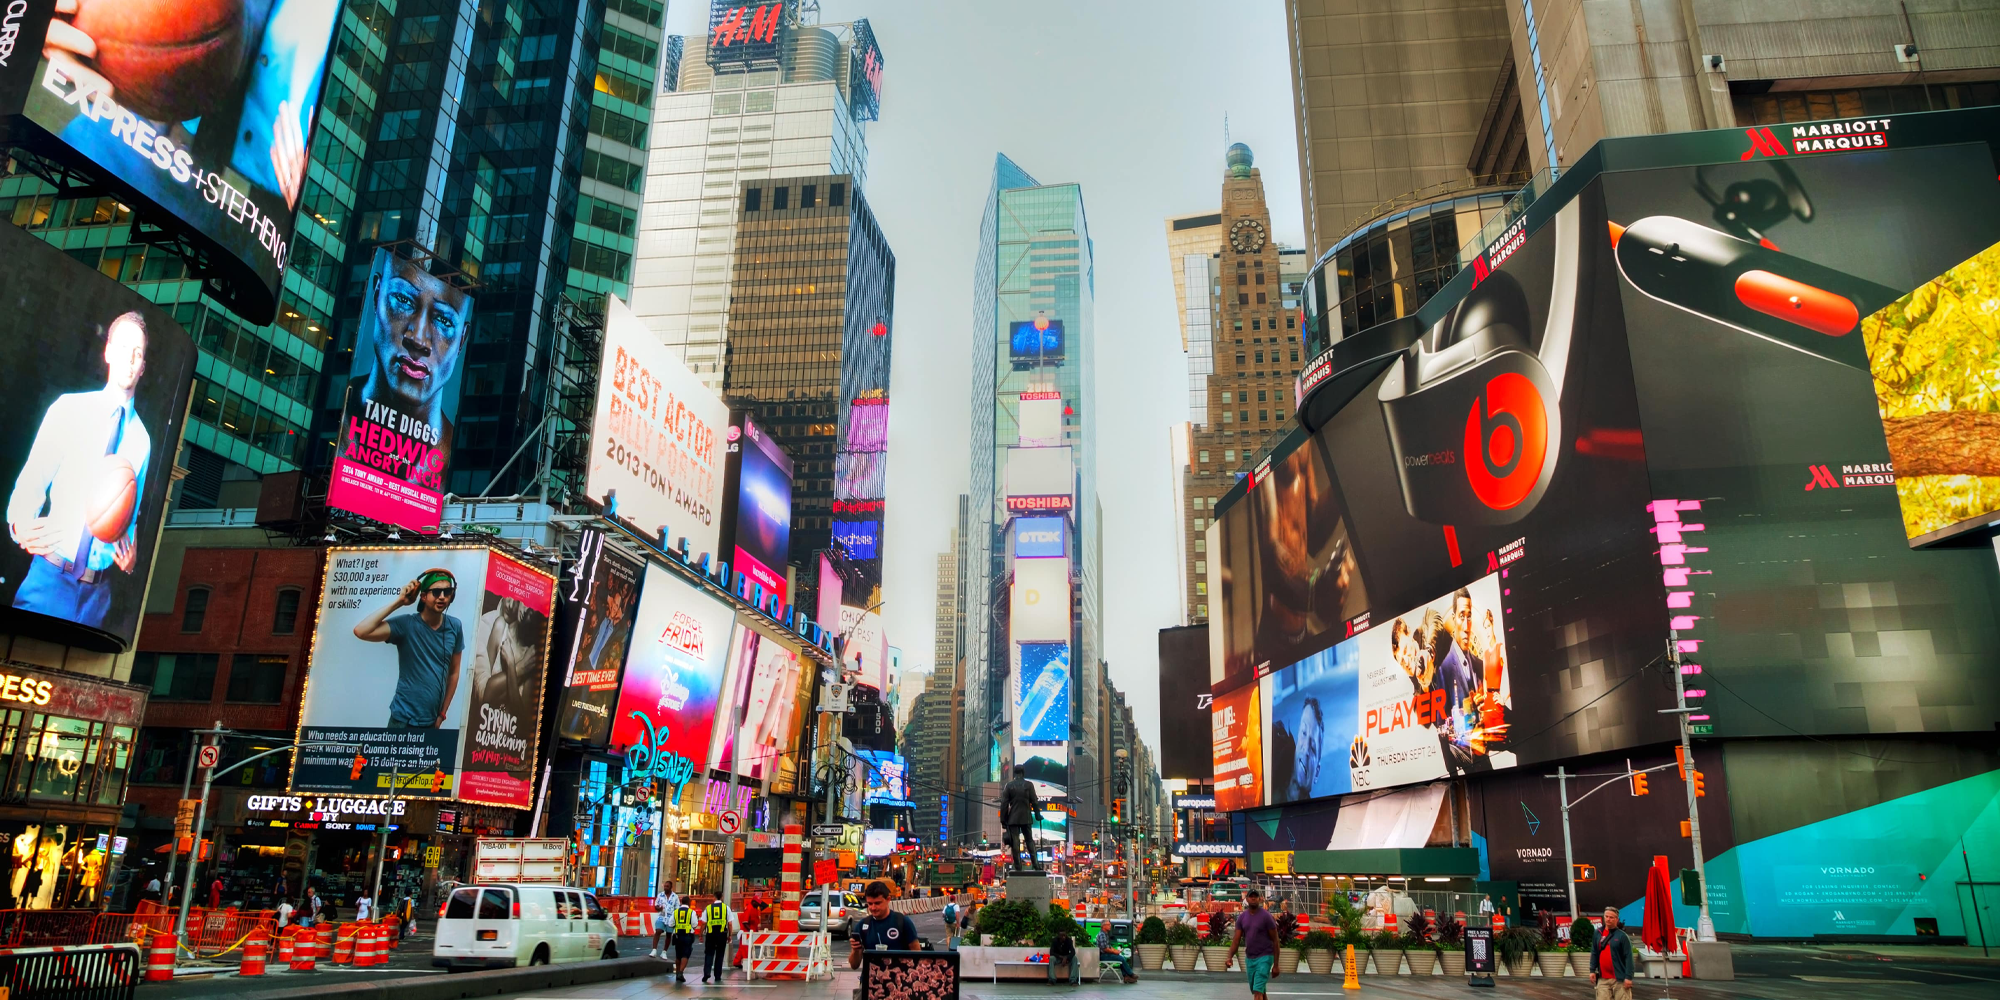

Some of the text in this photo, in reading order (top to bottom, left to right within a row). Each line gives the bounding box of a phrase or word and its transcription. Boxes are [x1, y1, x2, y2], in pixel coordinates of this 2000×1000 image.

[711, 3, 783, 47] H&M
[863, 44, 883, 102] H&M
[1792, 119, 1891, 138] MARRIOTT
[1795, 134, 1884, 152] MARQUIS
[1489, 214, 1527, 257] MARRIOTT
[1491, 232, 1525, 270] MARQUIS
[1302, 349, 1334, 380] MARRIOTT
[613, 345, 662, 420] BEST
[1302, 364, 1331, 393] MARQUIS
[1020, 392, 1061, 400] TOSHIBA
[364, 399, 440, 446] TAYE DIGGS
[348, 415, 445, 474] HEDWIG
[608, 392, 715, 506] BILLY PORTER
[726, 443, 739, 453] LG
[345, 442, 442, 491] ANGRY INCH
[1404, 450, 1456, 469] powerbeats
[388, 481, 400, 493] BEST
[401, 487, 419, 499] MUSICAL
[605, 436, 641, 477] 2013
[642, 461, 673, 501] TONY
[674, 488, 712, 527] AWARD
[1008, 496, 1071, 509] TOSHIBA
[1028, 531, 1060, 543] TDK
[1498, 536, 1526, 555] MARRIOTT
[336, 558, 360, 569] What?
[364, 559, 379, 571] get
[1499, 548, 1524, 565] MARQUIS
[333, 571, 389, 584] $30,000 a year
[752, 564, 769, 583] Incredible
[331, 585, 402, 597] with no experience
[1025, 588, 1040, 606] D
[328, 599, 362, 609] or skills?
[736, 571, 846, 656] BROADWA
[672, 610, 703, 634] FORCE
[661, 621, 704, 656] FRIDAY
[571, 670, 616, 685] BEST TIME EVER
[1366, 688, 1447, 738] PLAYER
[1383, 703, 1395, 714] THE
[874, 705, 882, 735] 1500
[308, 730, 425, 743] Who needs an education or hard
[475, 724, 528, 761] awakening
[363, 743, 389, 755] Cuomo
[390, 744, 397, 755] is
[398, 744, 424, 757] raising
[426, 745, 439, 756] the
[1377, 744, 1437, 767] THURSDAY SEPT 24
[303, 755, 337, 766] minimum
[338, 757, 353, 768] wag
[370, 756, 380, 767] 15
[1352, 769, 1371, 788] NBC
[247, 795, 406, 816] GIFTS LUGGAGE
[252, 820, 265, 828] Apple
[321, 813, 339, 822] NY
[325, 822, 352, 830] SONY
[940, 795, 949, 841] NYGARD
[1178, 842, 1244, 854] AÉROPOSTALE
[1516, 847, 1552, 858] VORNADO
[1820, 866, 1875, 875] VORNADO
[850, 883, 863, 892] CAT
